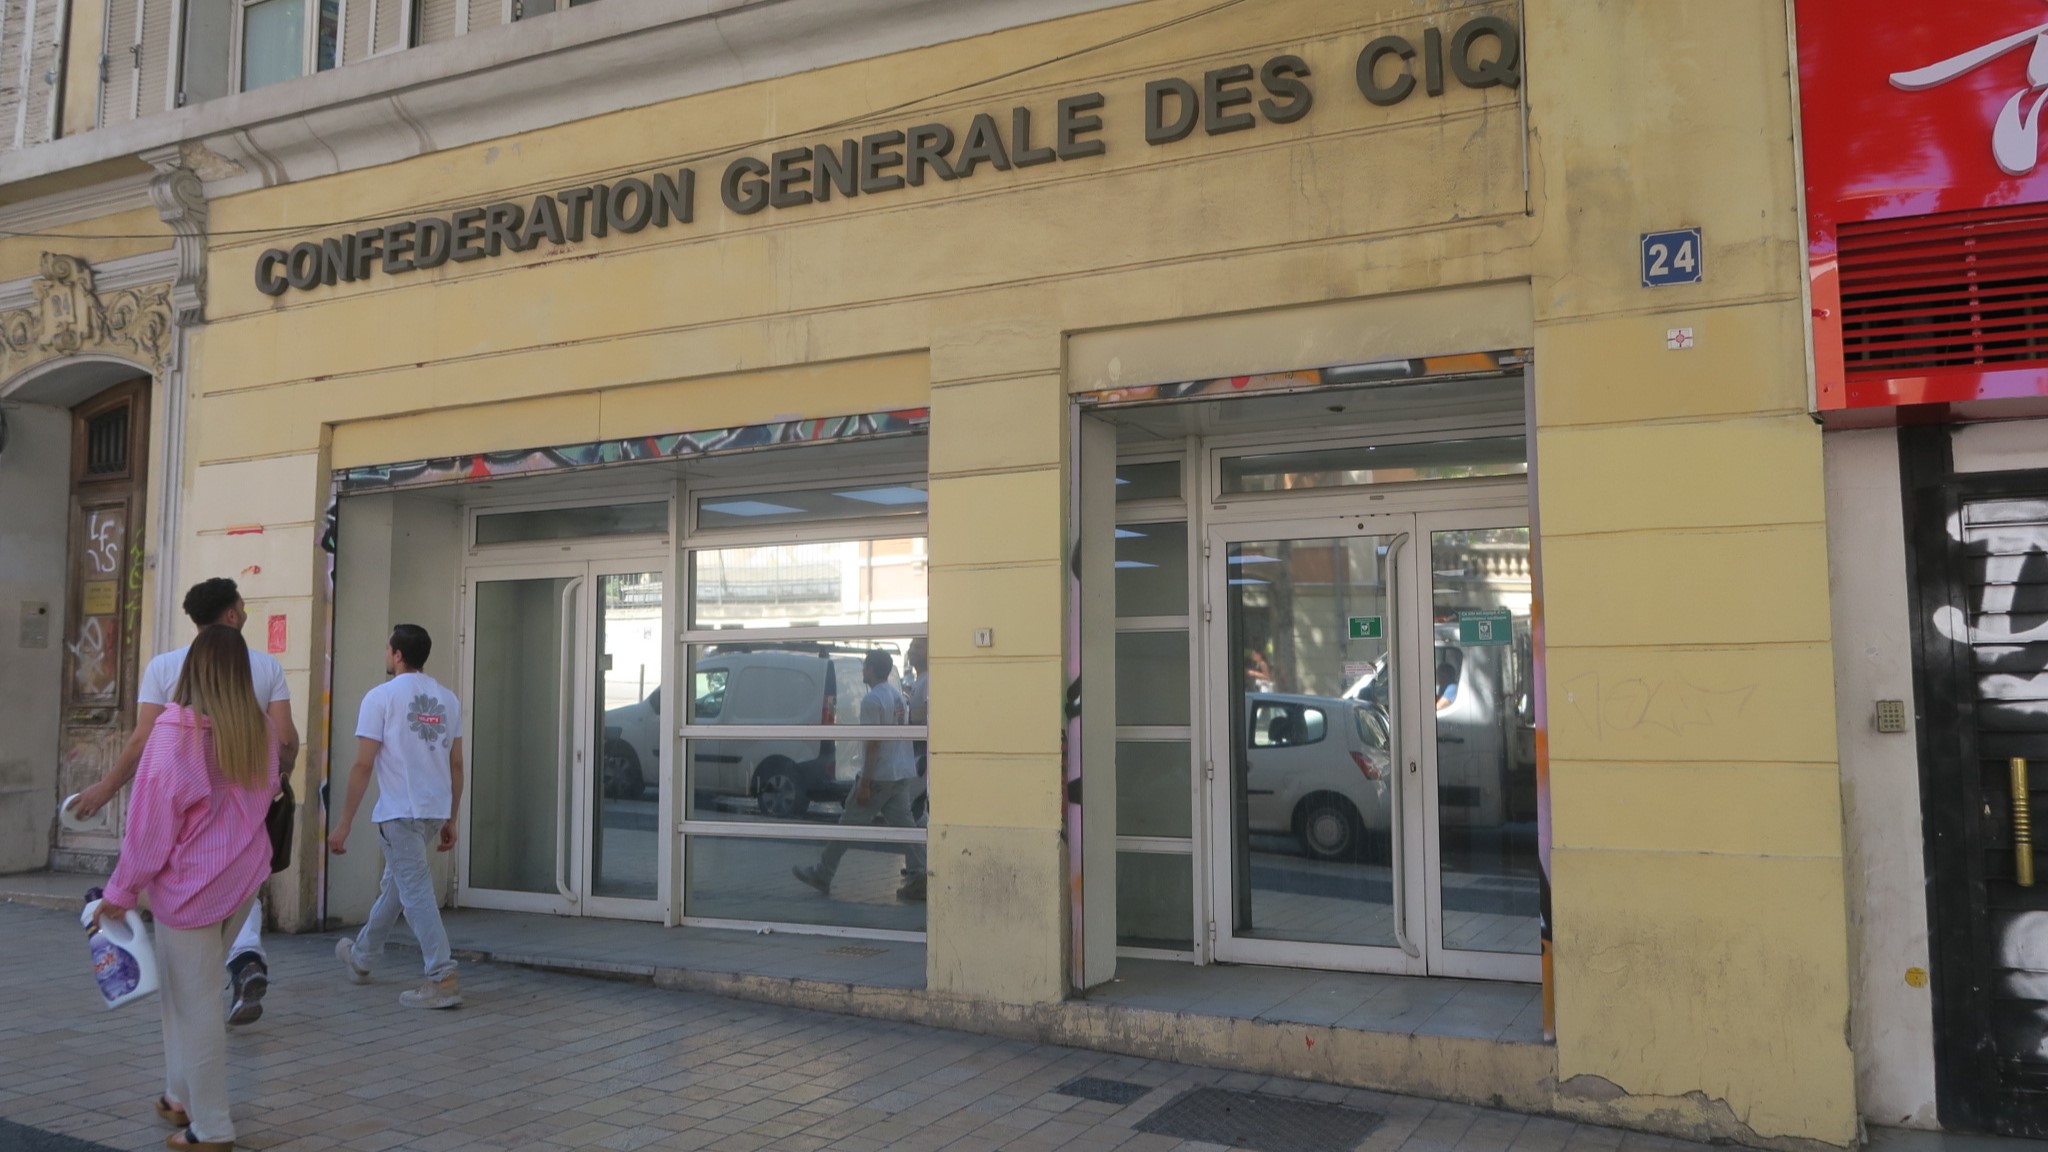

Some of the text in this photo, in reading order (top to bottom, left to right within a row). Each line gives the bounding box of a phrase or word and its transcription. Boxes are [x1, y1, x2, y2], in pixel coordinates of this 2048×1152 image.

[254, 16, 1521, 297] CONFEDERATION GENERALE DES CIQ
[1649, 240, 1695, 277] 24
